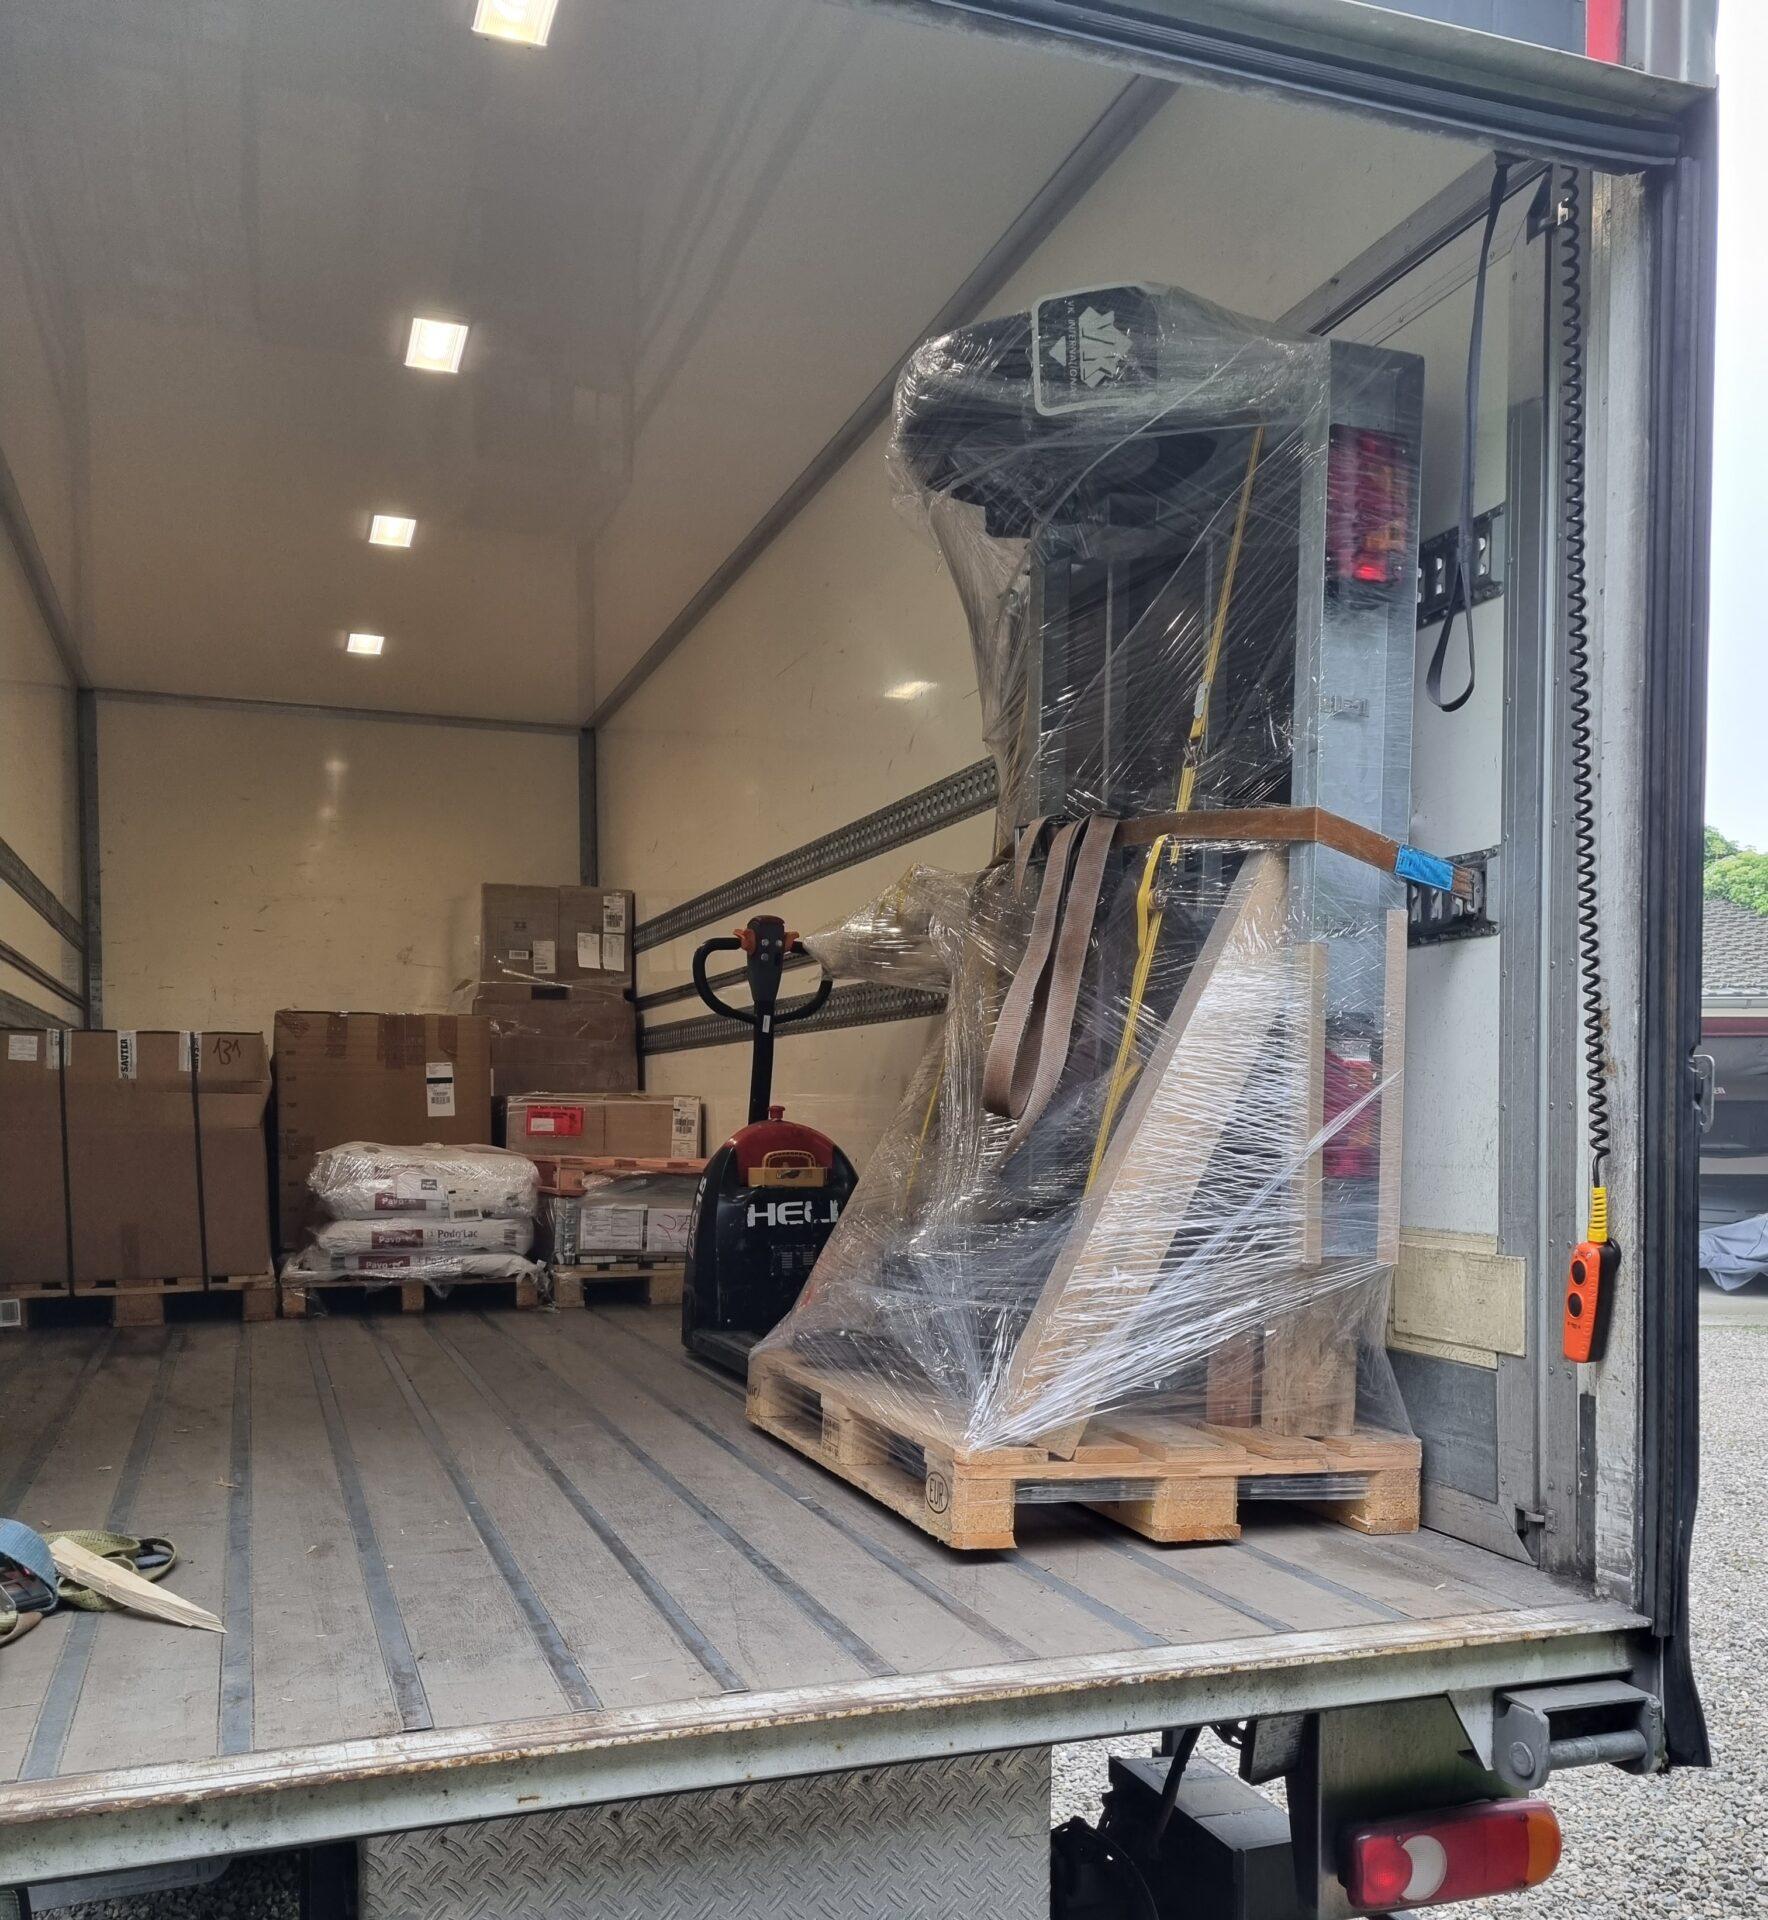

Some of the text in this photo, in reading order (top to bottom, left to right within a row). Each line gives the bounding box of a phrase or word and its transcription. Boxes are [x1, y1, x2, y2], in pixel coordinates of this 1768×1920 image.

[120, 1039, 129, 1072] SAUTER
[378, 1235, 401, 1244] Pavo
[365, 1261, 388, 1269] Pavo
[929, 1478, 943, 1508] EUR
